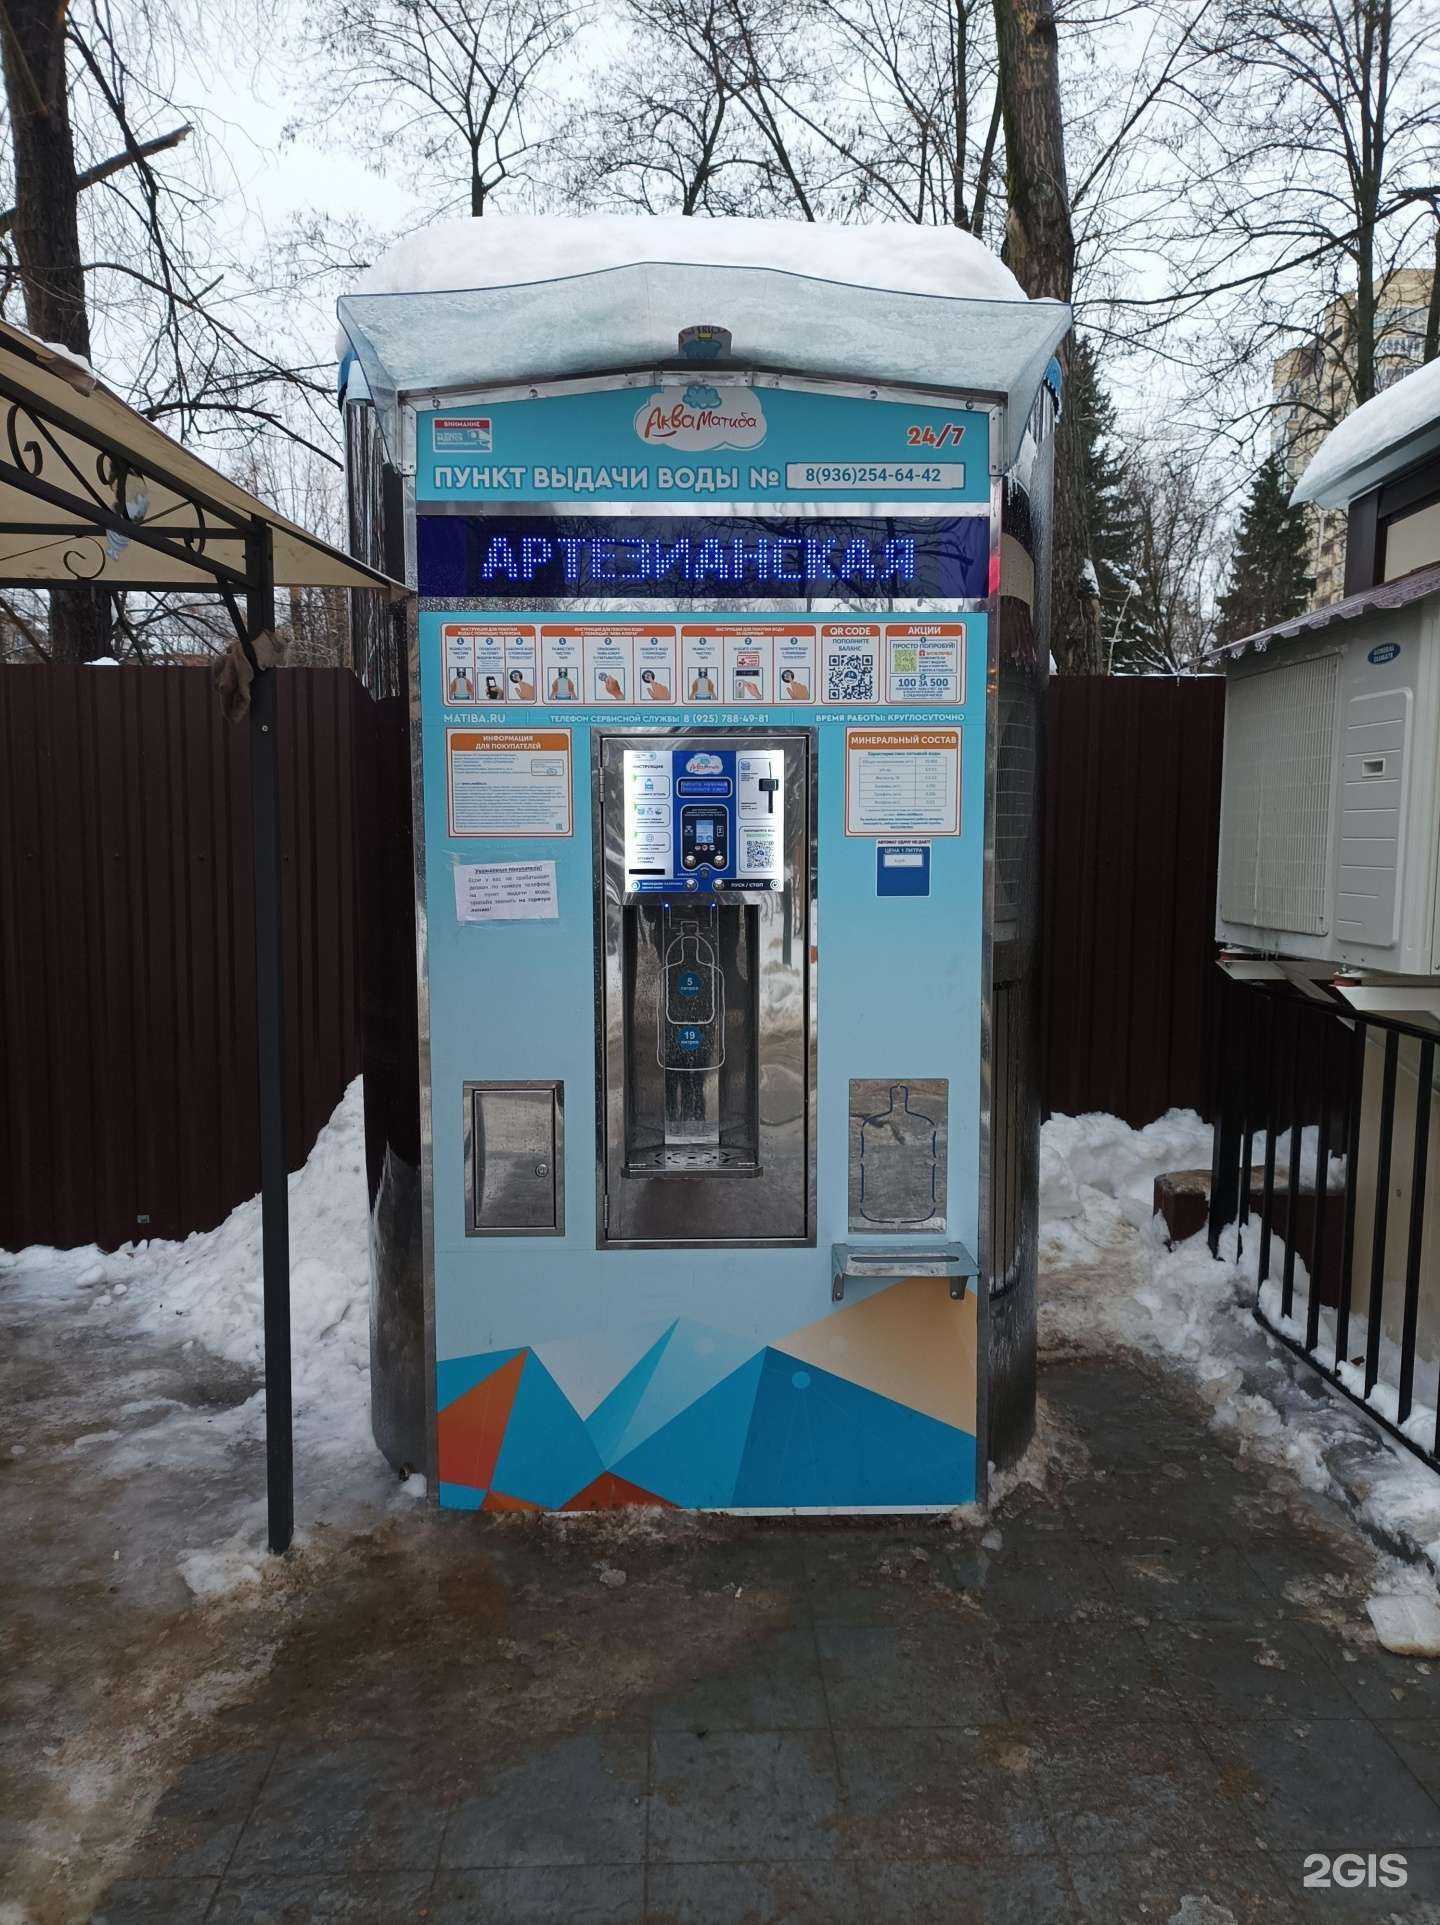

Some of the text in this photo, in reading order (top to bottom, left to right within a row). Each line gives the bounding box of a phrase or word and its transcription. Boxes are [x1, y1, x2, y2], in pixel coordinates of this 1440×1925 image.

[908, 424, 965, 448] 24/7
[434, 466, 942, 492] ПУНКТ ВЫДАЧИ ВОДЫ № 8(936)254-64-42
[482, 536, 915, 580] АРТЕЗИАНСКАЯ
[830, 627, 871, 635] QR CODE
[908, 627, 942, 636] АКЦИИ
[898, 679, 916, 687] 100
[930, 679, 949, 687] 500
[443, 713, 505, 723] MATIBA.RU
[591, 714, 640, 722] СЕРВИСНОЙ
[683, 714, 690, 722] 8
[693, 714, 718, 724] (925)
[721, 714, 769, 722] 788-49-81
[848, 713, 886, 721] РАБОТЫ:
[888, 713, 964, 721] КРУГЛОСУТОЧНО
[851, 735, 957, 744] МИНЕРАЛЬНЫЙ СОСТАВ
[687, 977, 693, 986] 5
[684, 1031, 695, 1040] 19
